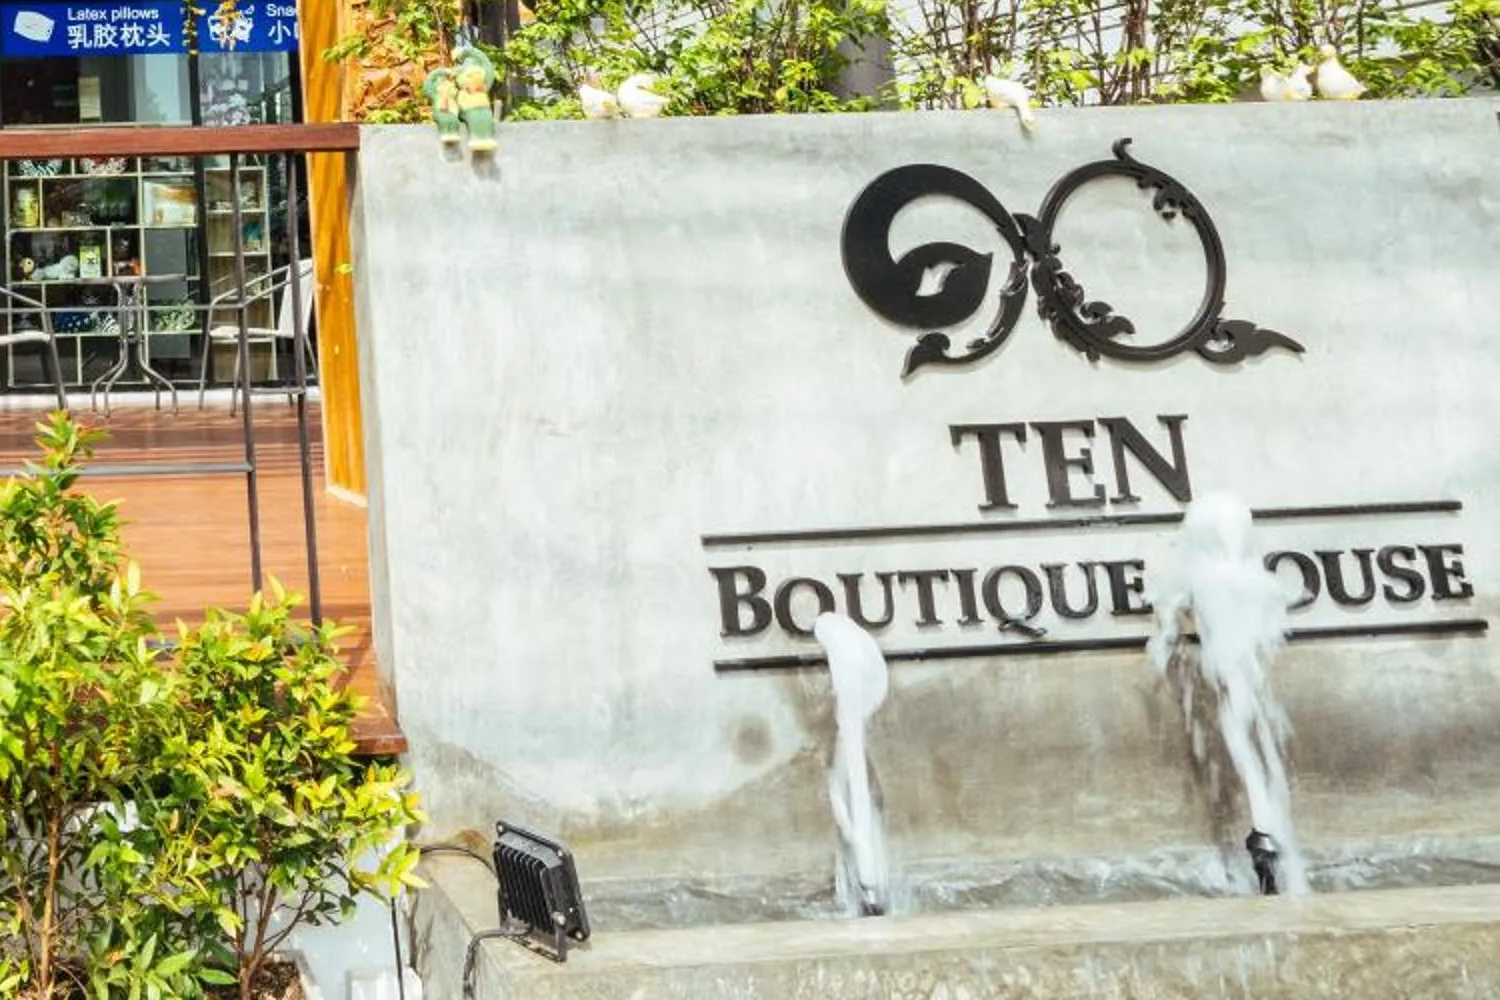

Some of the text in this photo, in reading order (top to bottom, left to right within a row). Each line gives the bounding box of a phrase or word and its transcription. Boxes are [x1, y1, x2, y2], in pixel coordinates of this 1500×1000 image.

[67, 6, 159, 24] Latex pillows
[266, 3, 296, 17] Sna
[67, 23, 171, 48] 乳胶枕头
[268, 19, 299, 45] 小
[950, 414, 1193, 511] TEN
[709, 543, 1475, 638] BOUTIQUE OUSE
